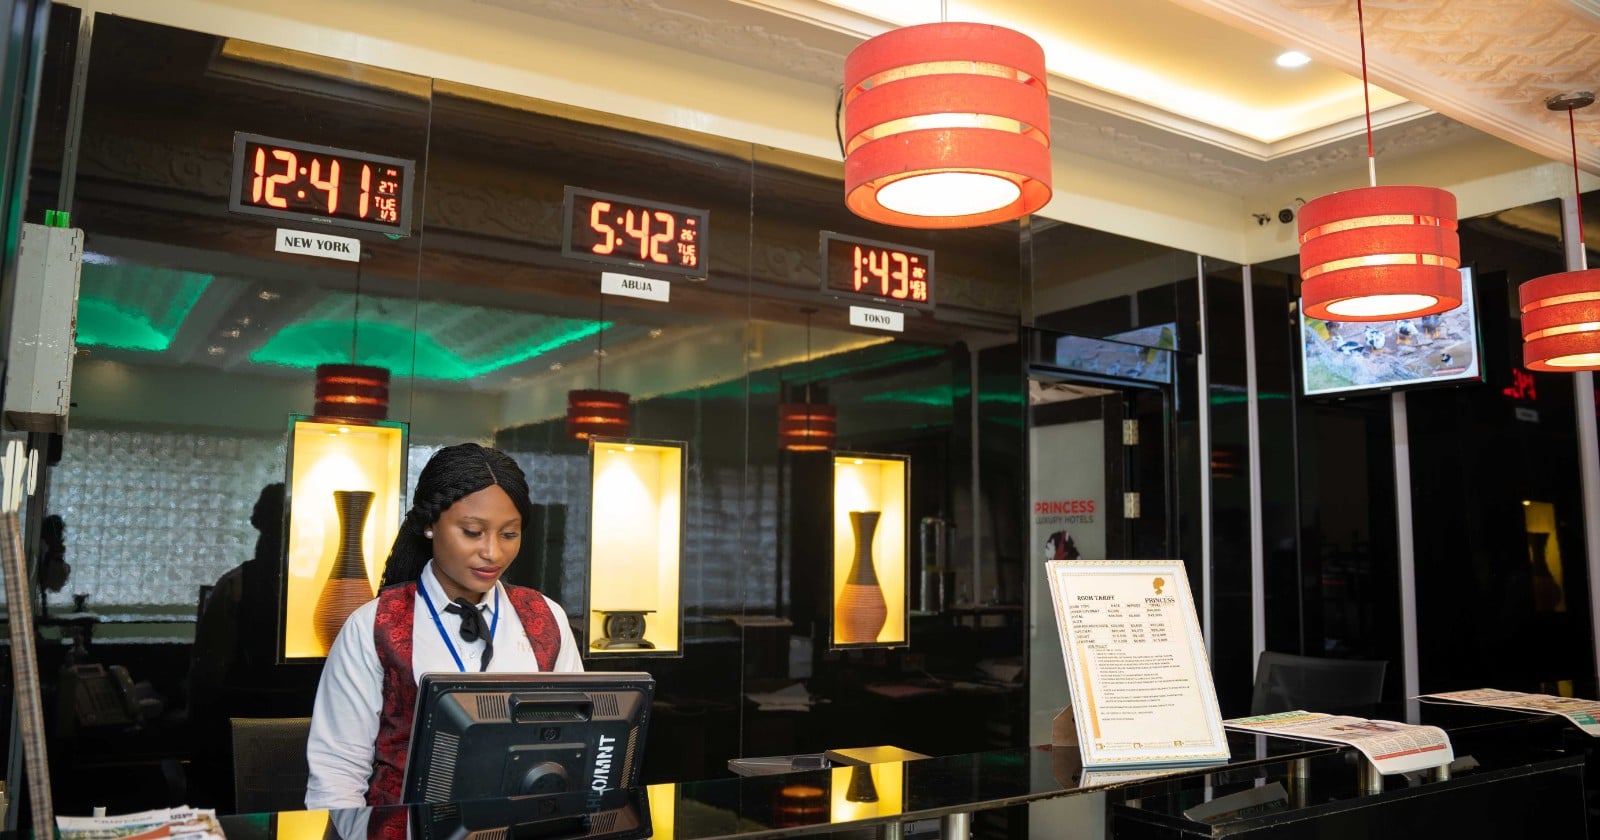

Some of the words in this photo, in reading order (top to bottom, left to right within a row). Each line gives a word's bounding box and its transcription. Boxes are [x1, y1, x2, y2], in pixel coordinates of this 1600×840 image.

[252, 147, 371, 218] 12:41
[374, 196, 397, 211] TUE
[590, 201, 675, 264] 5:42
[284, 235, 313, 249] NEW
[316, 239, 351, 253] YORK
[677, 243, 696, 256] TUE
[854, 246, 909, 299] 1:43
[621, 278, 653, 292] ABUJA
[863, 313, 891, 325] TOKYO
[1034, 499, 1095, 514] PRINCESS
[1064, 514, 1094, 524] HOTELS
[1144, 597, 1176, 605] PRINCESS
